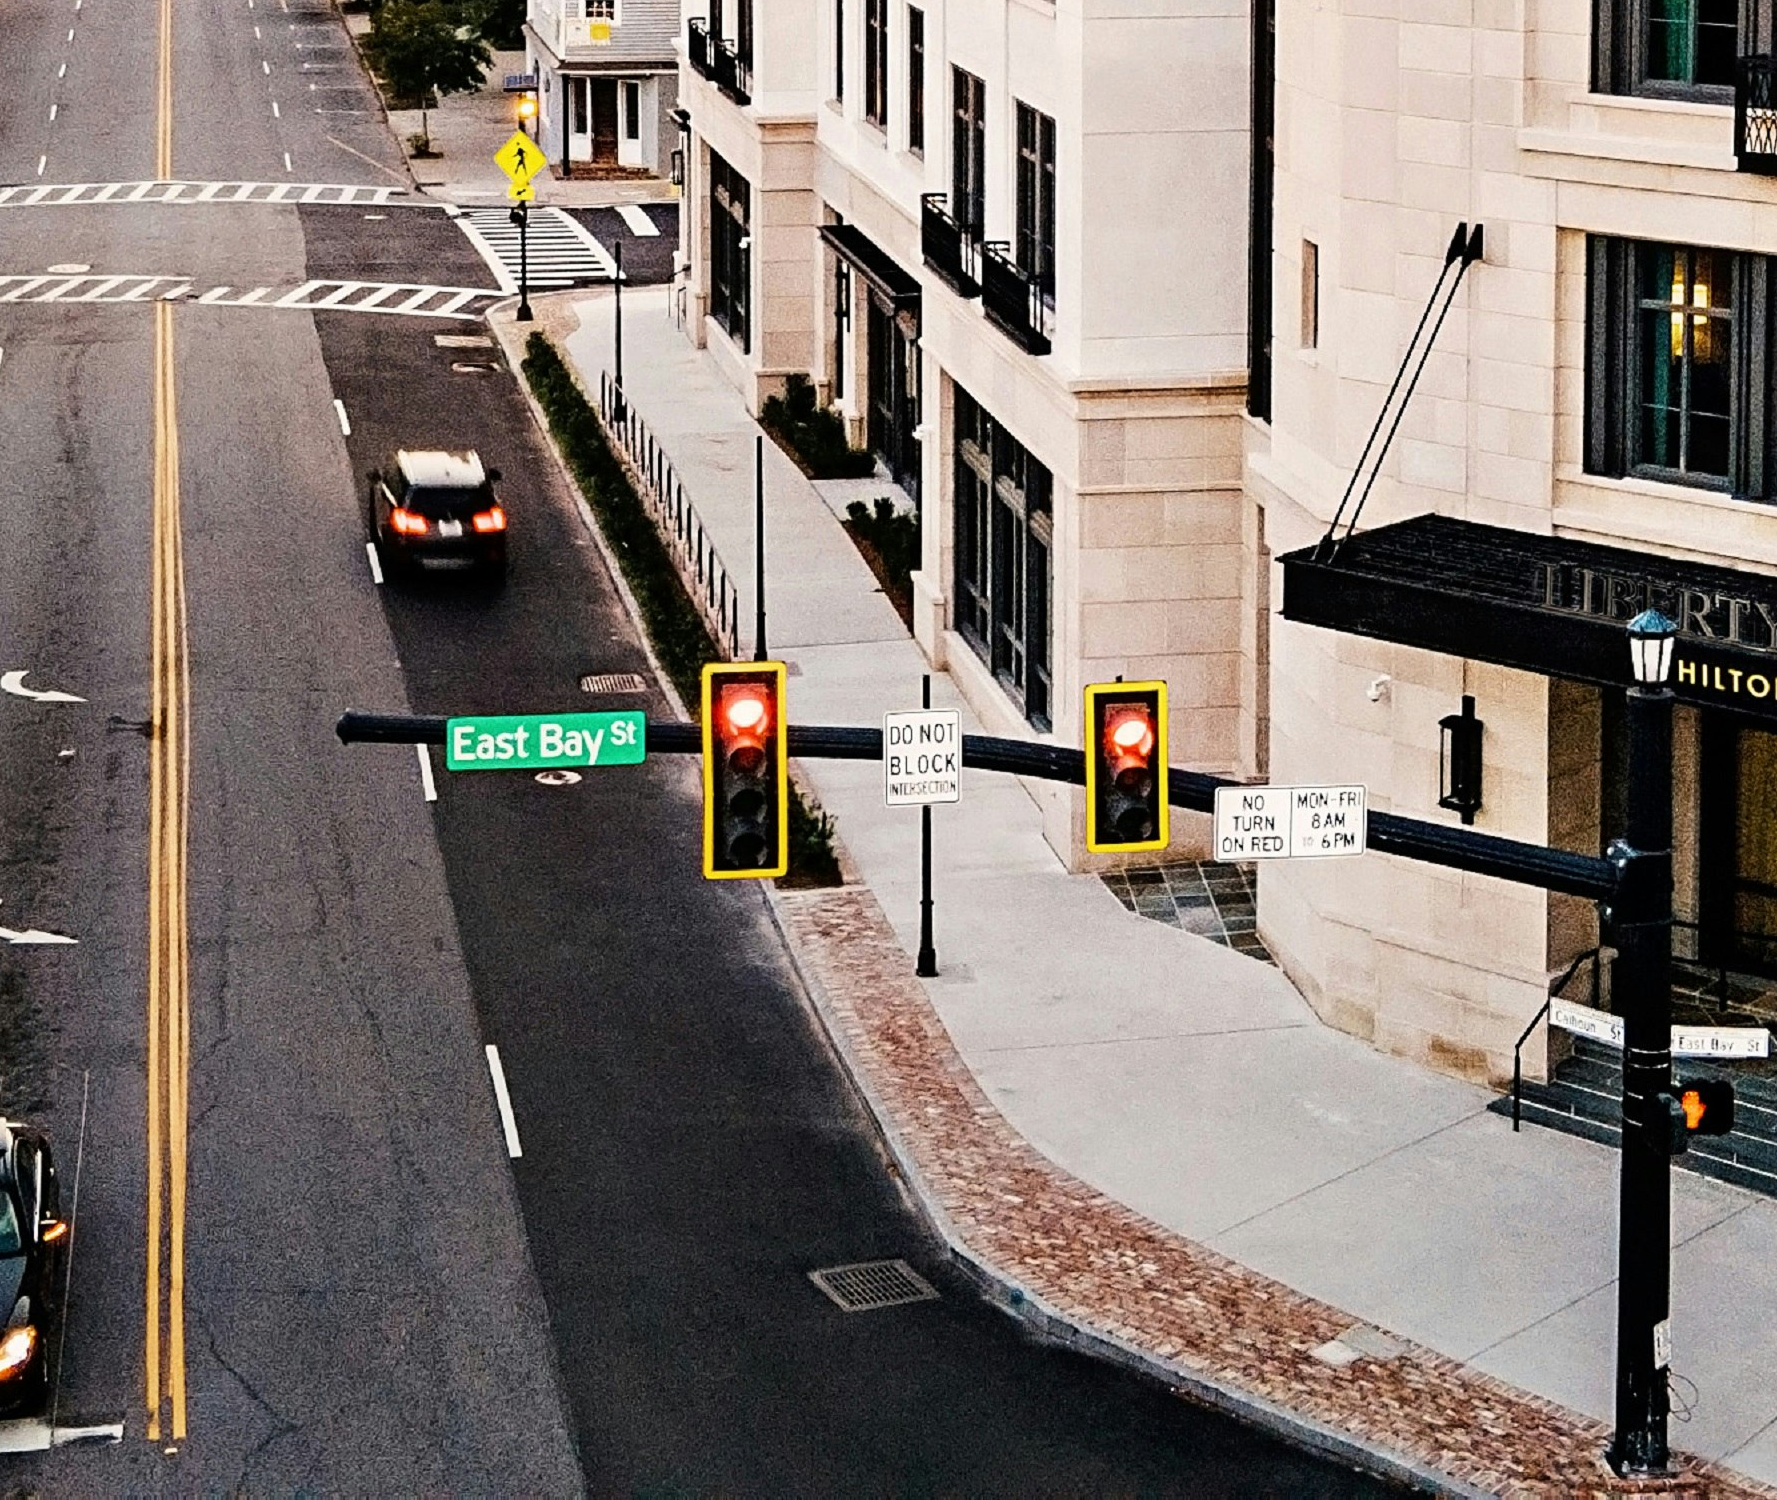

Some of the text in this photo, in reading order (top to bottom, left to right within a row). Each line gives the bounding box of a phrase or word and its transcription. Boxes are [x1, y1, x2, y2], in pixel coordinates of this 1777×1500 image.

[453, 720, 637, 765] East Bay St
[890, 723, 956, 745] DO NOT
[890, 753, 956, 775] BLOCK
[890, 781, 956, 796] INTERSECTION
[1243, 795, 1265, 811] NO
[1233, 816, 1275, 832] TURN
[1222, 836, 1284, 853] ON RED
[1610, 1024, 1622, 1041] St
